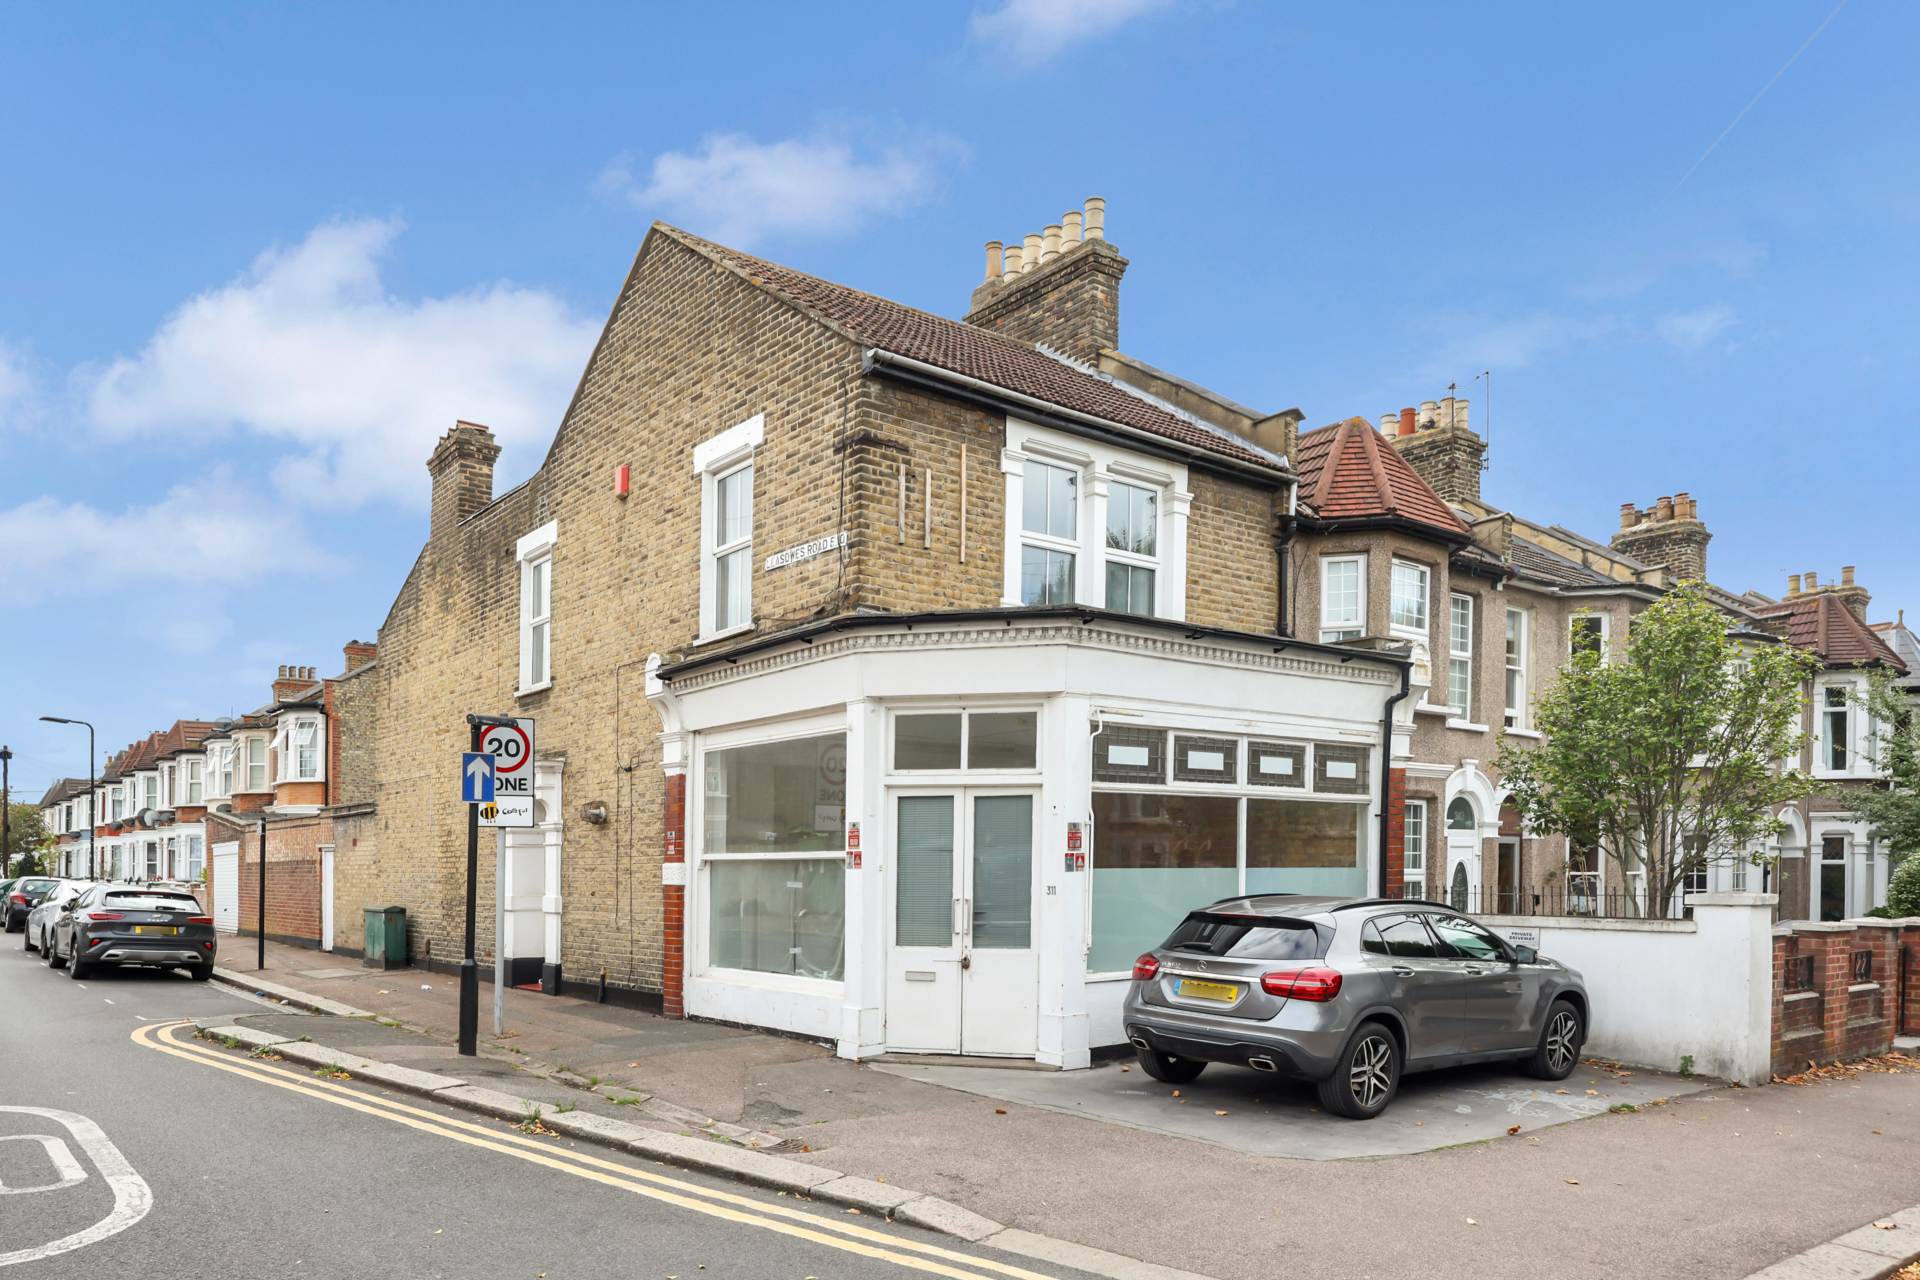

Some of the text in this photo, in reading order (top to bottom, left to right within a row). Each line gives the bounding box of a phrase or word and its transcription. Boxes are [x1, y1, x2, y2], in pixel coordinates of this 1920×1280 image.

[487, 737, 521, 758] 20
[496, 777, 528, 792] ONE
[1046, 885, 1057, 896] 311
